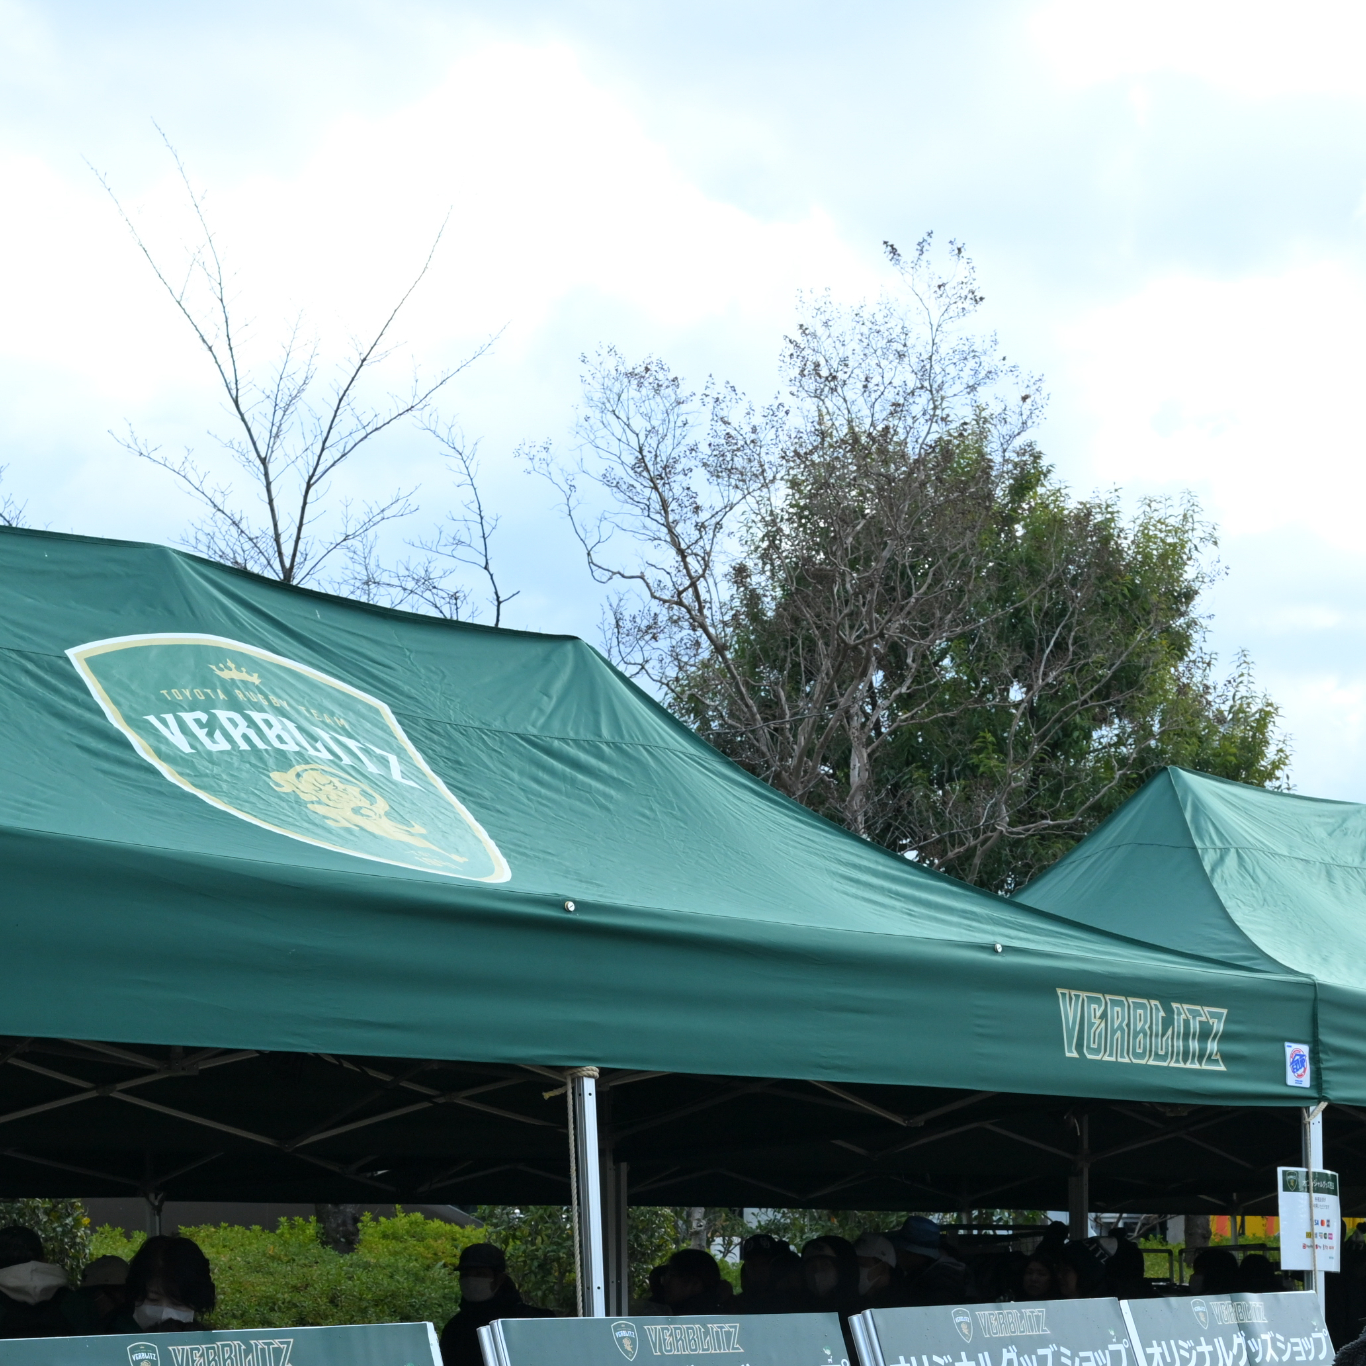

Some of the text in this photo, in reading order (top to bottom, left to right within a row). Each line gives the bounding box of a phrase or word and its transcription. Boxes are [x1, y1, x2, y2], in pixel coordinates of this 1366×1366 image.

[160, 687, 346, 726] TOYOTA RUGBY TEAM
[143, 709, 428, 793] VERBLITZ
[1055, 988, 1228, 1071] VERBLITZ
[643, 1322, 745, 1356] VERBLITZ
[975, 1308, 1051, 1338] VERBLITZ
